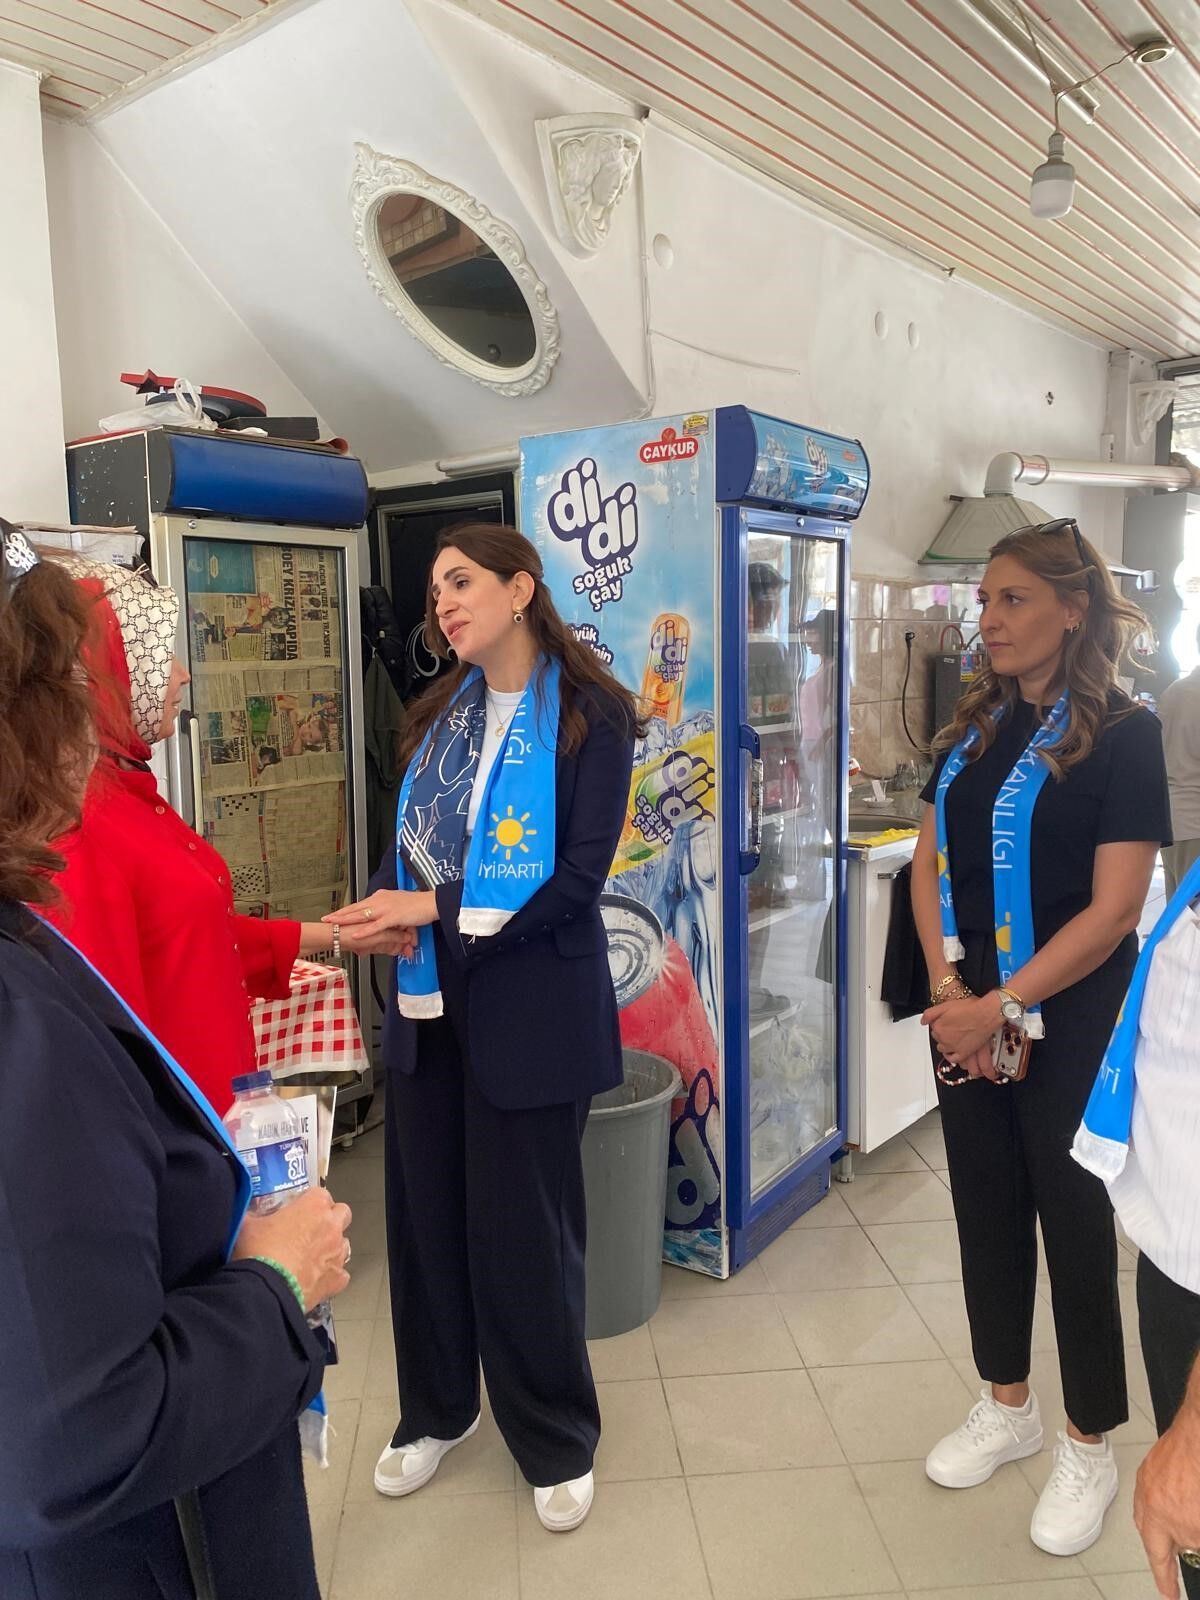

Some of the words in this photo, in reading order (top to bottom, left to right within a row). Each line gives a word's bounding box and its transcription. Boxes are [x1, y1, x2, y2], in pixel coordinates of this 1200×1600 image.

[642, 441, 696, 461] ÇAYKUR
[573, 556, 633, 591] soğuk
[589, 579, 624, 611] çay
